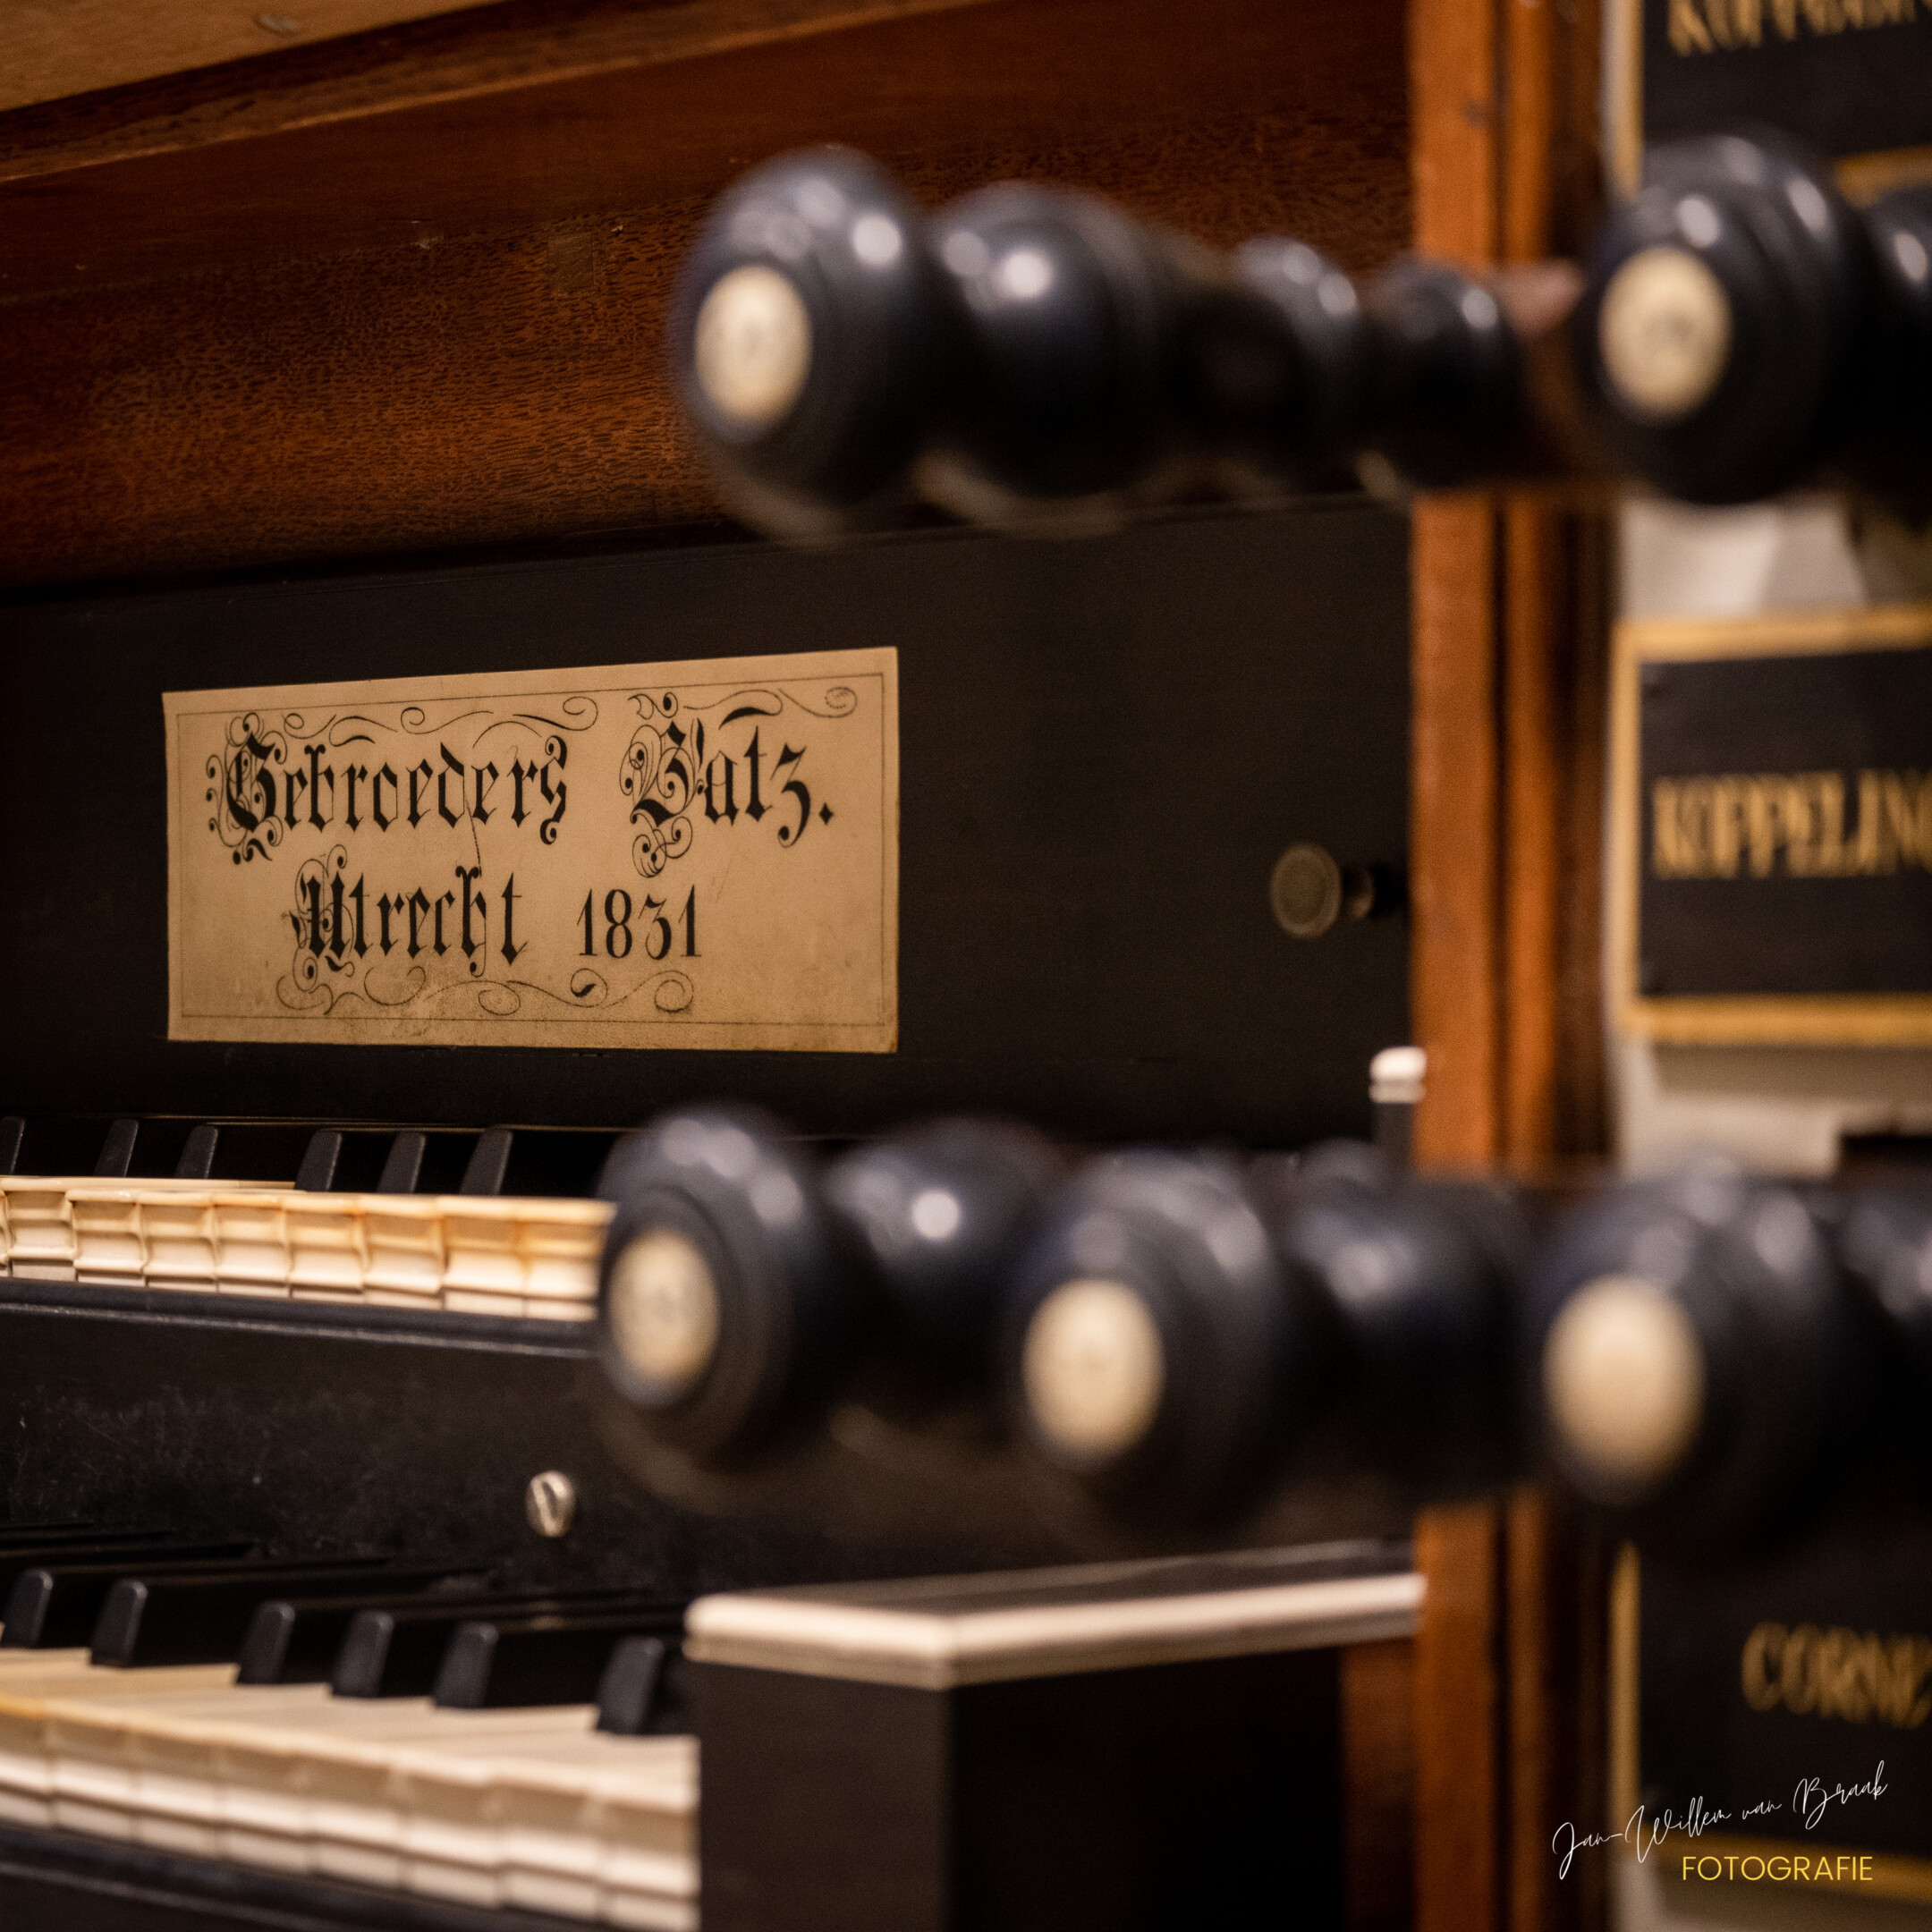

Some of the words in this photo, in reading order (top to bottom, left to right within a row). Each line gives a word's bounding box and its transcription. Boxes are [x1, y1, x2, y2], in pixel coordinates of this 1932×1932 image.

[207, 714, 568, 864] Gebroeders
[289, 860, 529, 979] Utrecht
[577, 884, 702, 961] 1831
